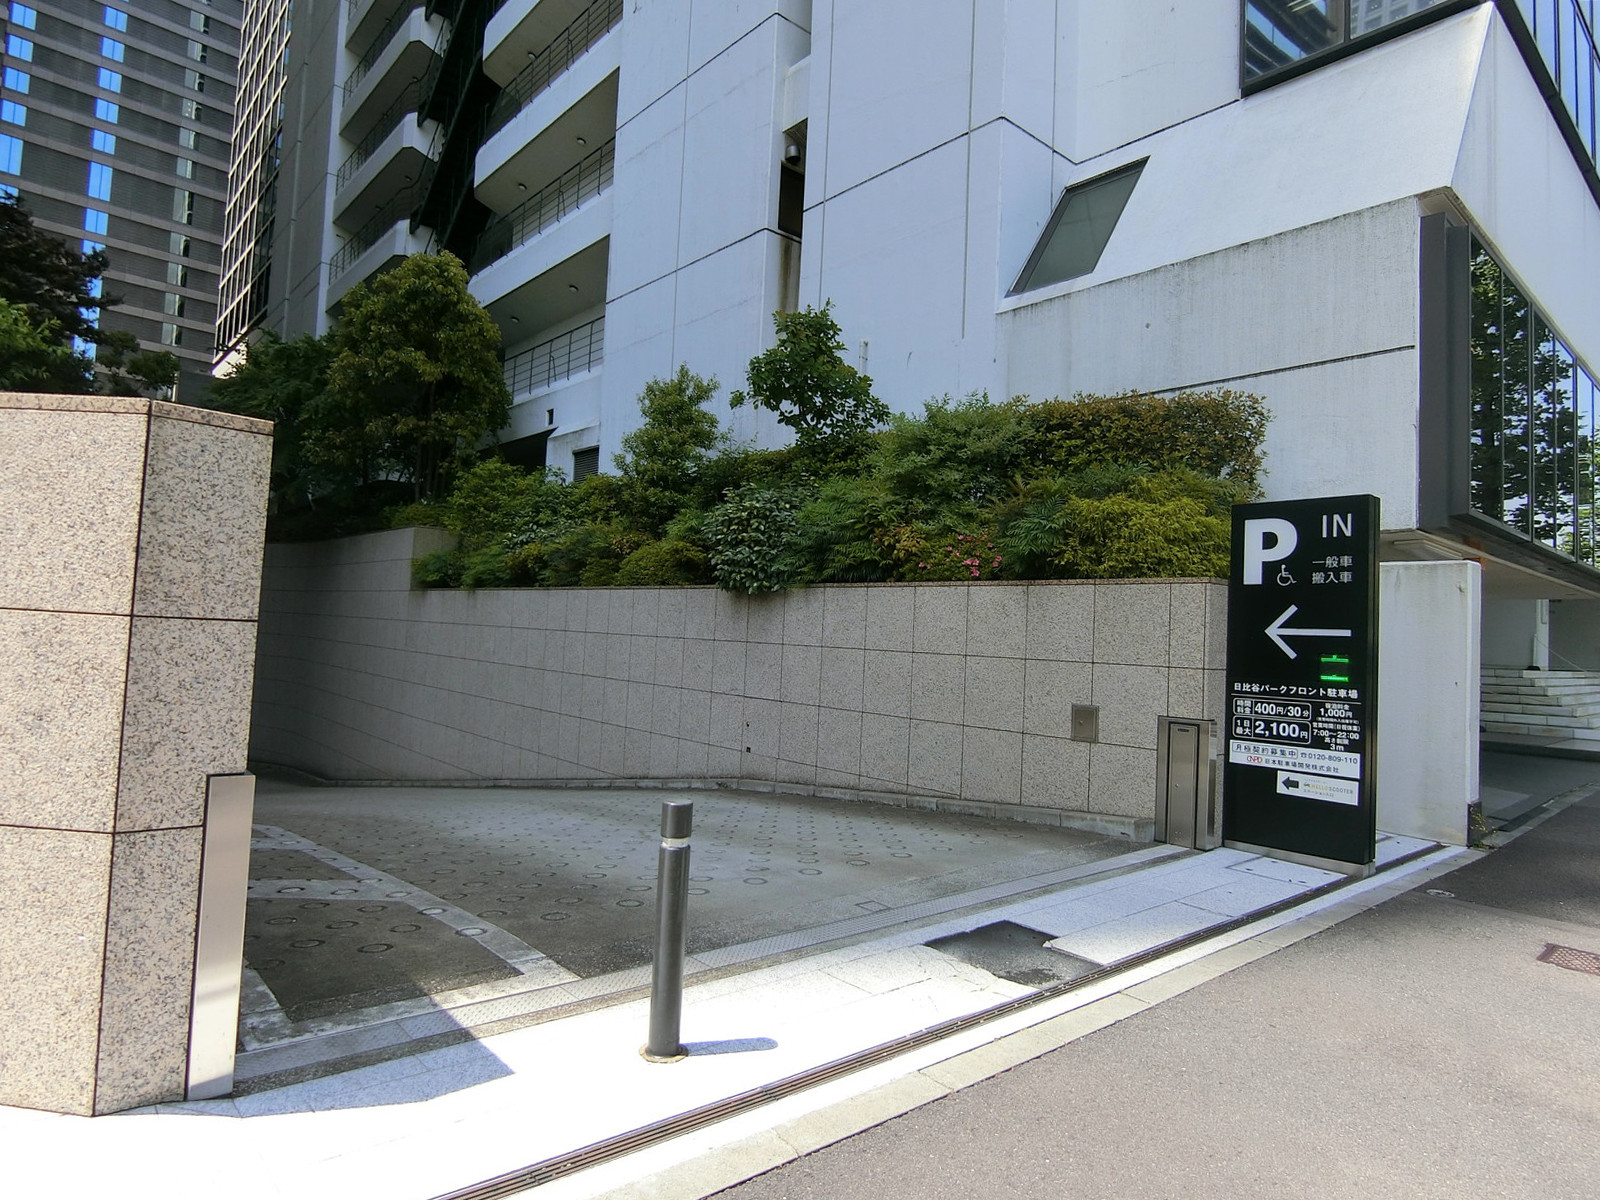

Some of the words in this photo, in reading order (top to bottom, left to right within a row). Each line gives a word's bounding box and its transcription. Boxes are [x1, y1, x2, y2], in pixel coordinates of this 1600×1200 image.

[1322, 513, 1352, 538] IN
[1243, 518, 1298, 585] P
[1312, 555, 1353, 568] 一般車
[1312, 571, 1353, 584] 搬入車
[1234, 682, 1359, 699] 日比谷パークフロント駐車場
[1236, 700, 1251, 708] 時間
[1236, 706, 1251, 714] 料金
[1319, 707, 1353, 718] 1,000円
[1236, 726, 1251, 736] 最大
